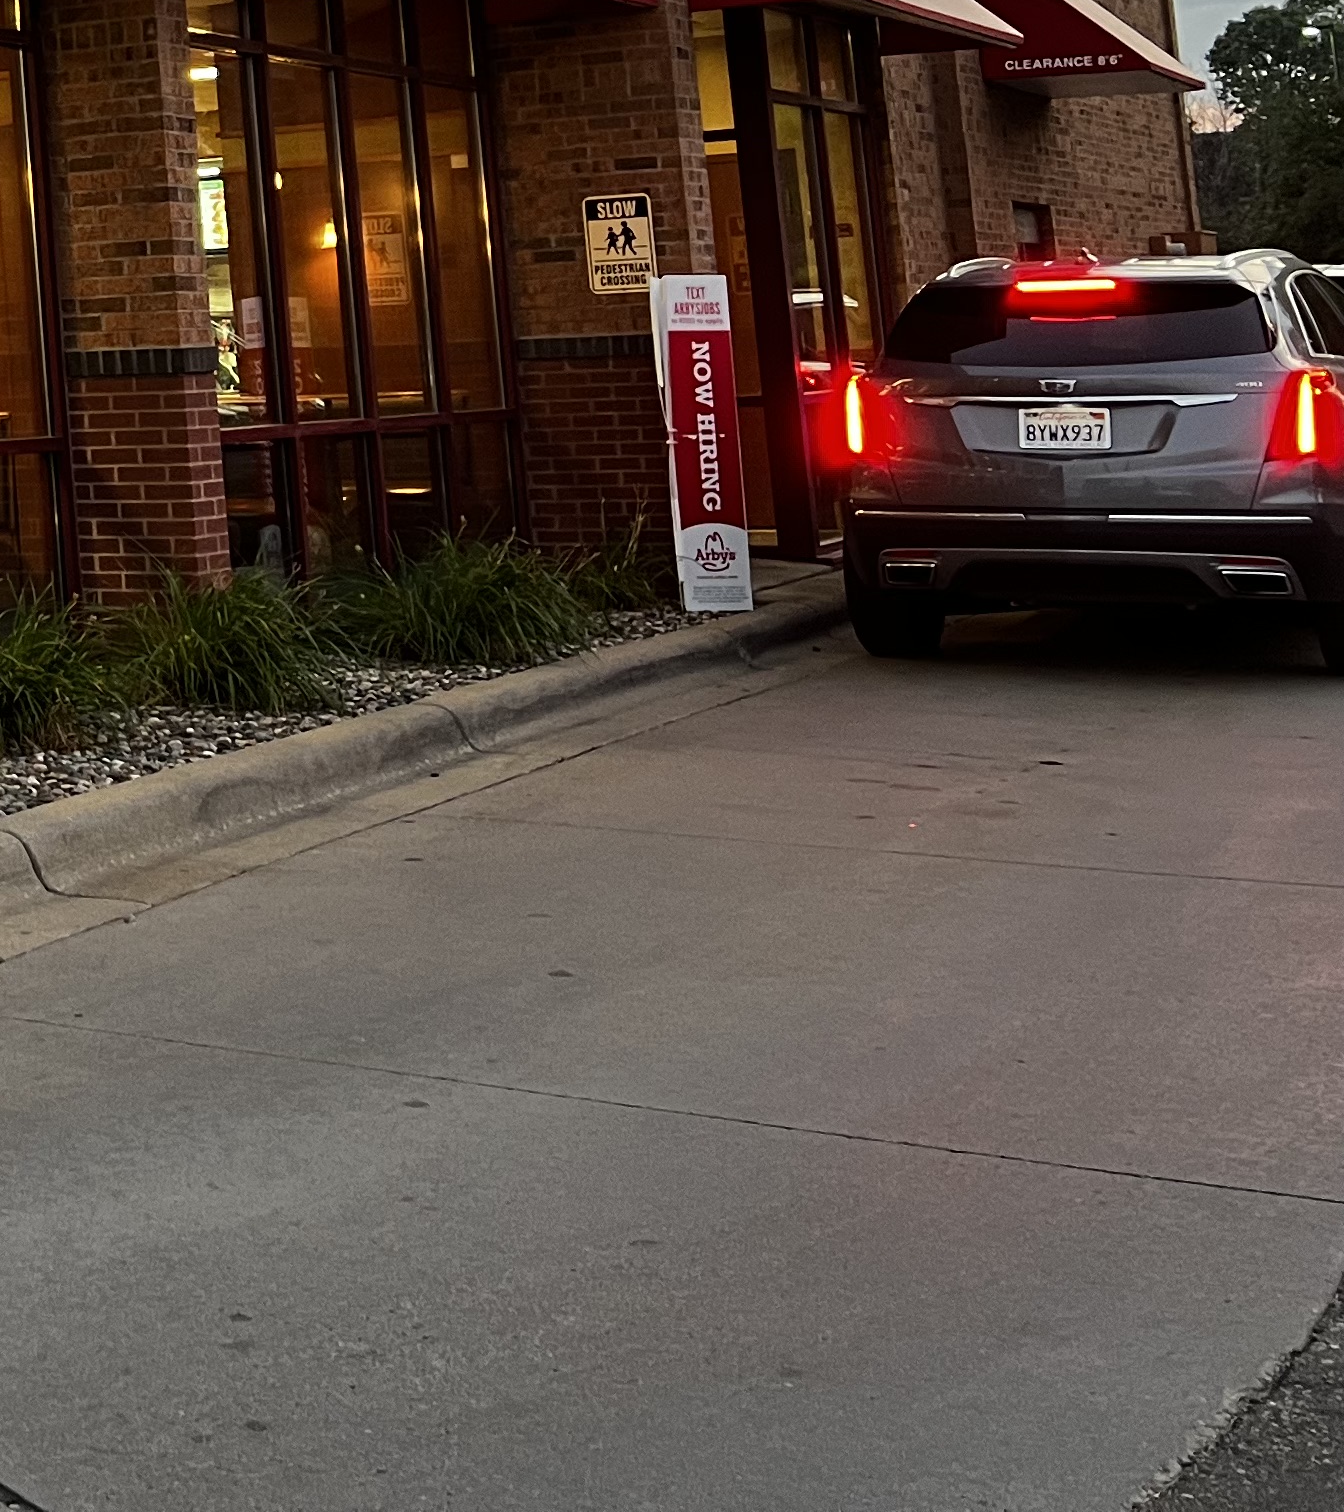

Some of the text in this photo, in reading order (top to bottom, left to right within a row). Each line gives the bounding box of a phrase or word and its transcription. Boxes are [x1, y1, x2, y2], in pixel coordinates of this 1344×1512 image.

[1004, 55, 1093, 70] CLEARANCE
[597, 200, 636, 218] SLOW
[594, 262, 651, 275] PEDESTRIAN
[600, 274, 647, 286] CROSSING
[686, 286, 705, 300] TEXT
[674, 301, 721, 315] ARBYSJOBS
[691, 341, 714, 407] NOW
[1026, 424, 1104, 441] 8YWX937
[697, 413, 721, 512] HIRING
[695, 548, 736, 564] Arby's
